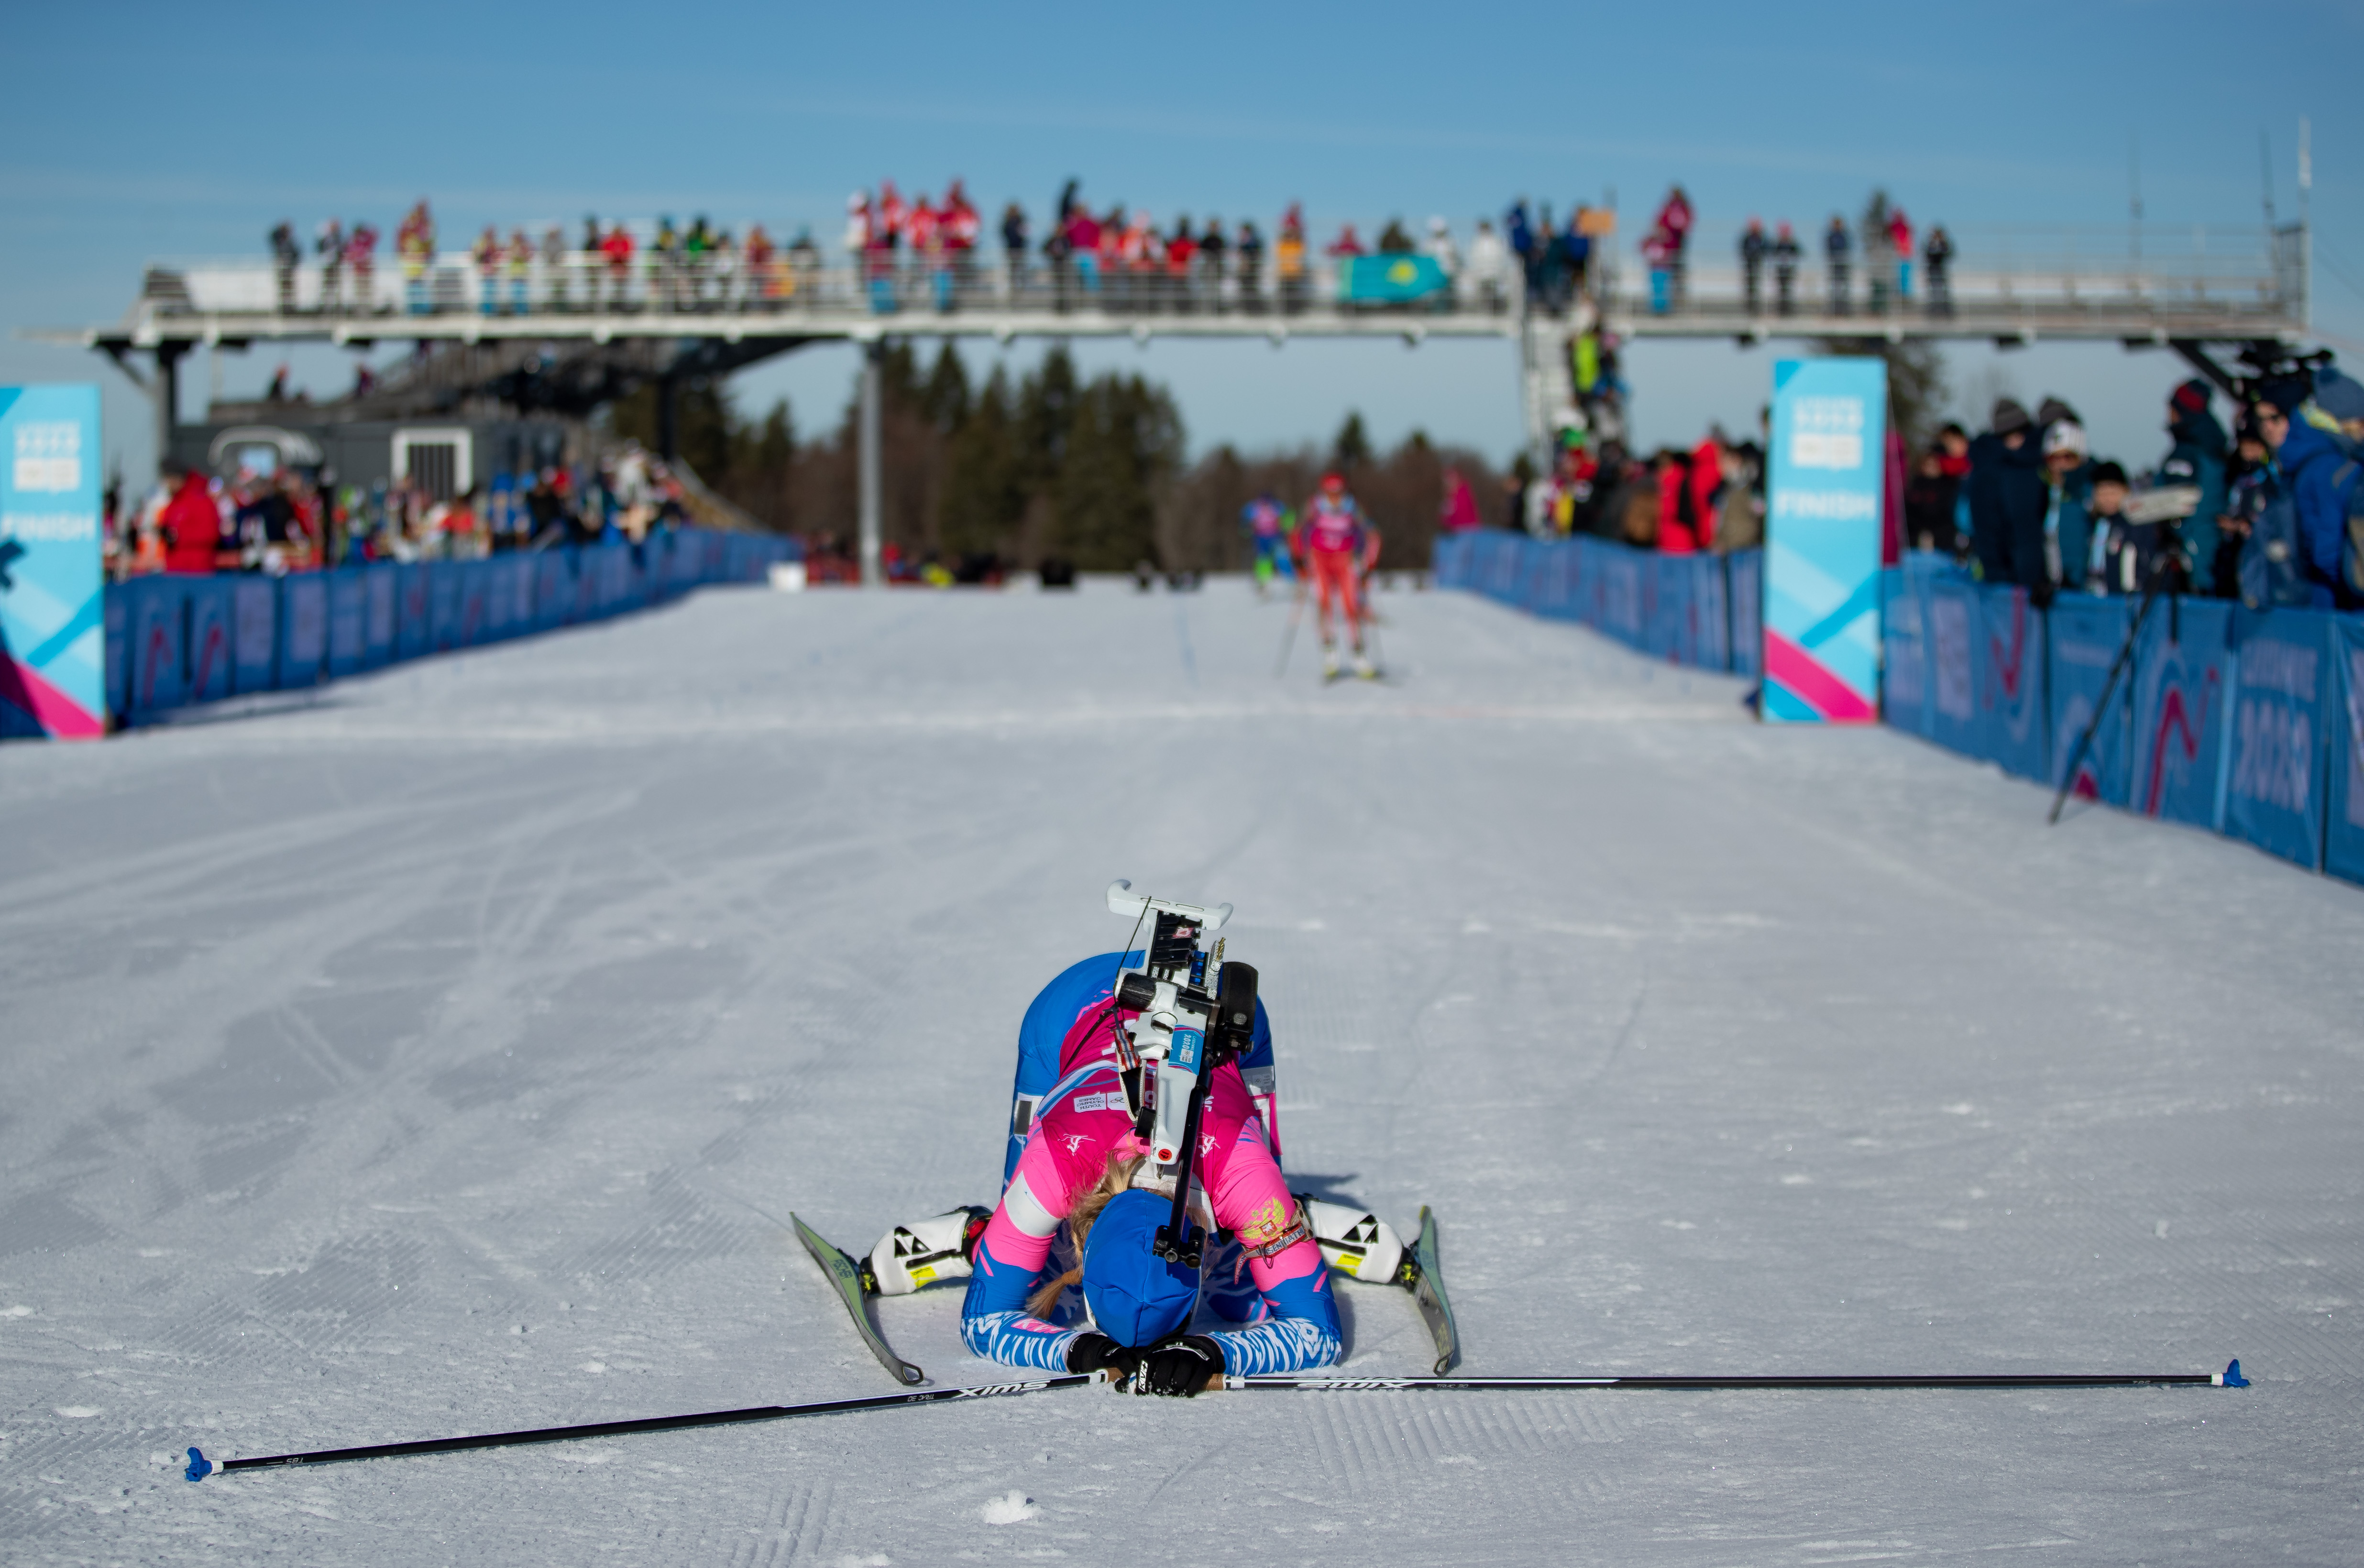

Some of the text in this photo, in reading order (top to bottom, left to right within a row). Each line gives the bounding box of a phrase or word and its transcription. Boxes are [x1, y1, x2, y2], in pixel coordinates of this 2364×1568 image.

[1775, 491, 1875, 518] FINISH
[2, 513, 94, 540] FINISH
[1182, 1034, 1192, 1049] 2020
[952, 1380, 1051, 1398] SWIX
